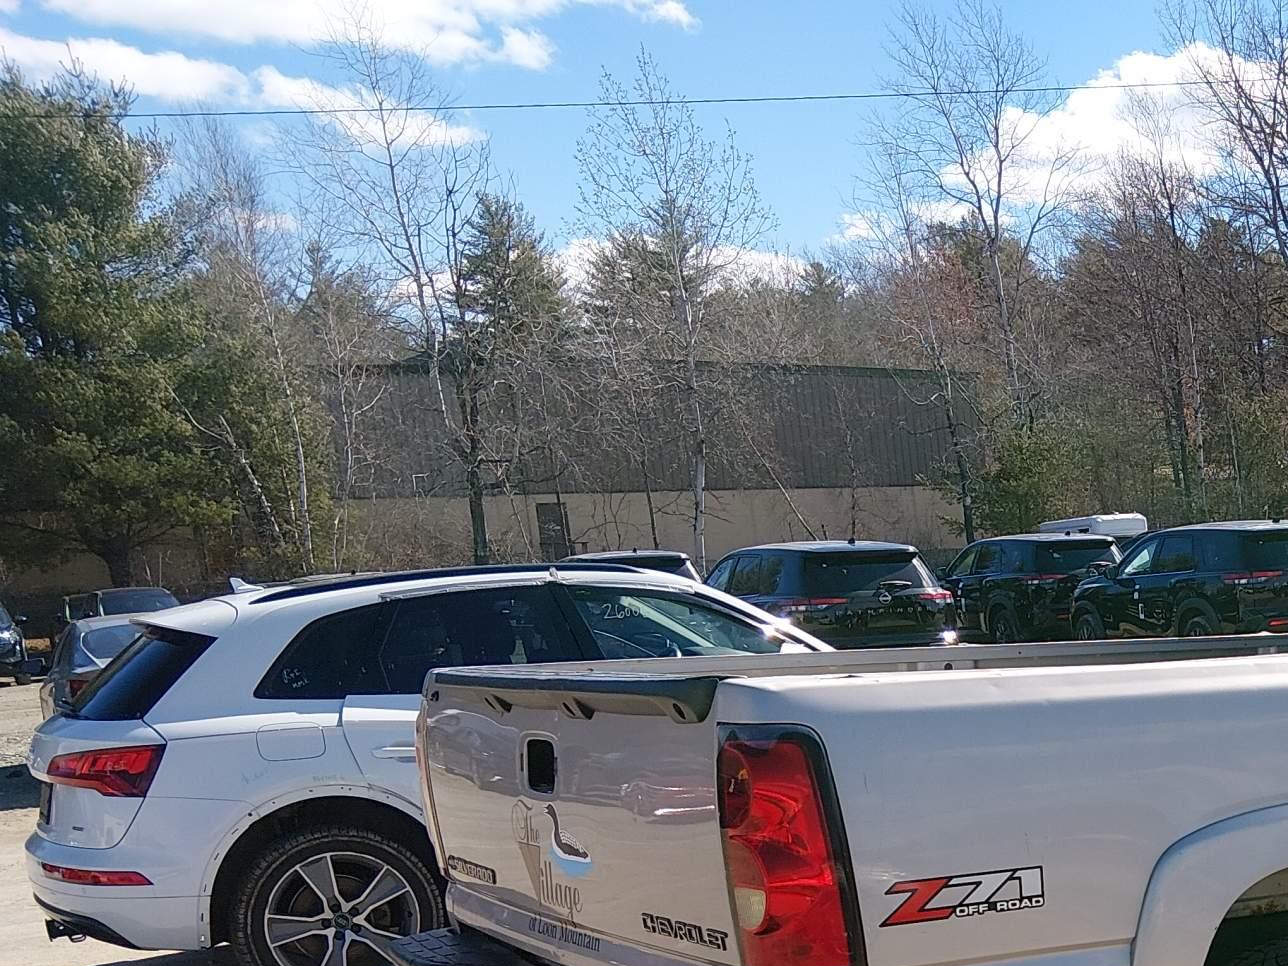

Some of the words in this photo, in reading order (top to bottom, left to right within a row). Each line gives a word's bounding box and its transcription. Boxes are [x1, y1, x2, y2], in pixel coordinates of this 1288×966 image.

[454, 859, 493, 883] SILVERADO
[879, 865, 1045, 928] Z71
[956, 903, 989, 917] OFF
[996, 897, 1044, 911] ROAD
[528, 913, 540, 931] of
[536, 916, 559, 940] Loon
[559, 919, 601, 952] Mountain
[641, 912, 729, 951] CHEVROLET
